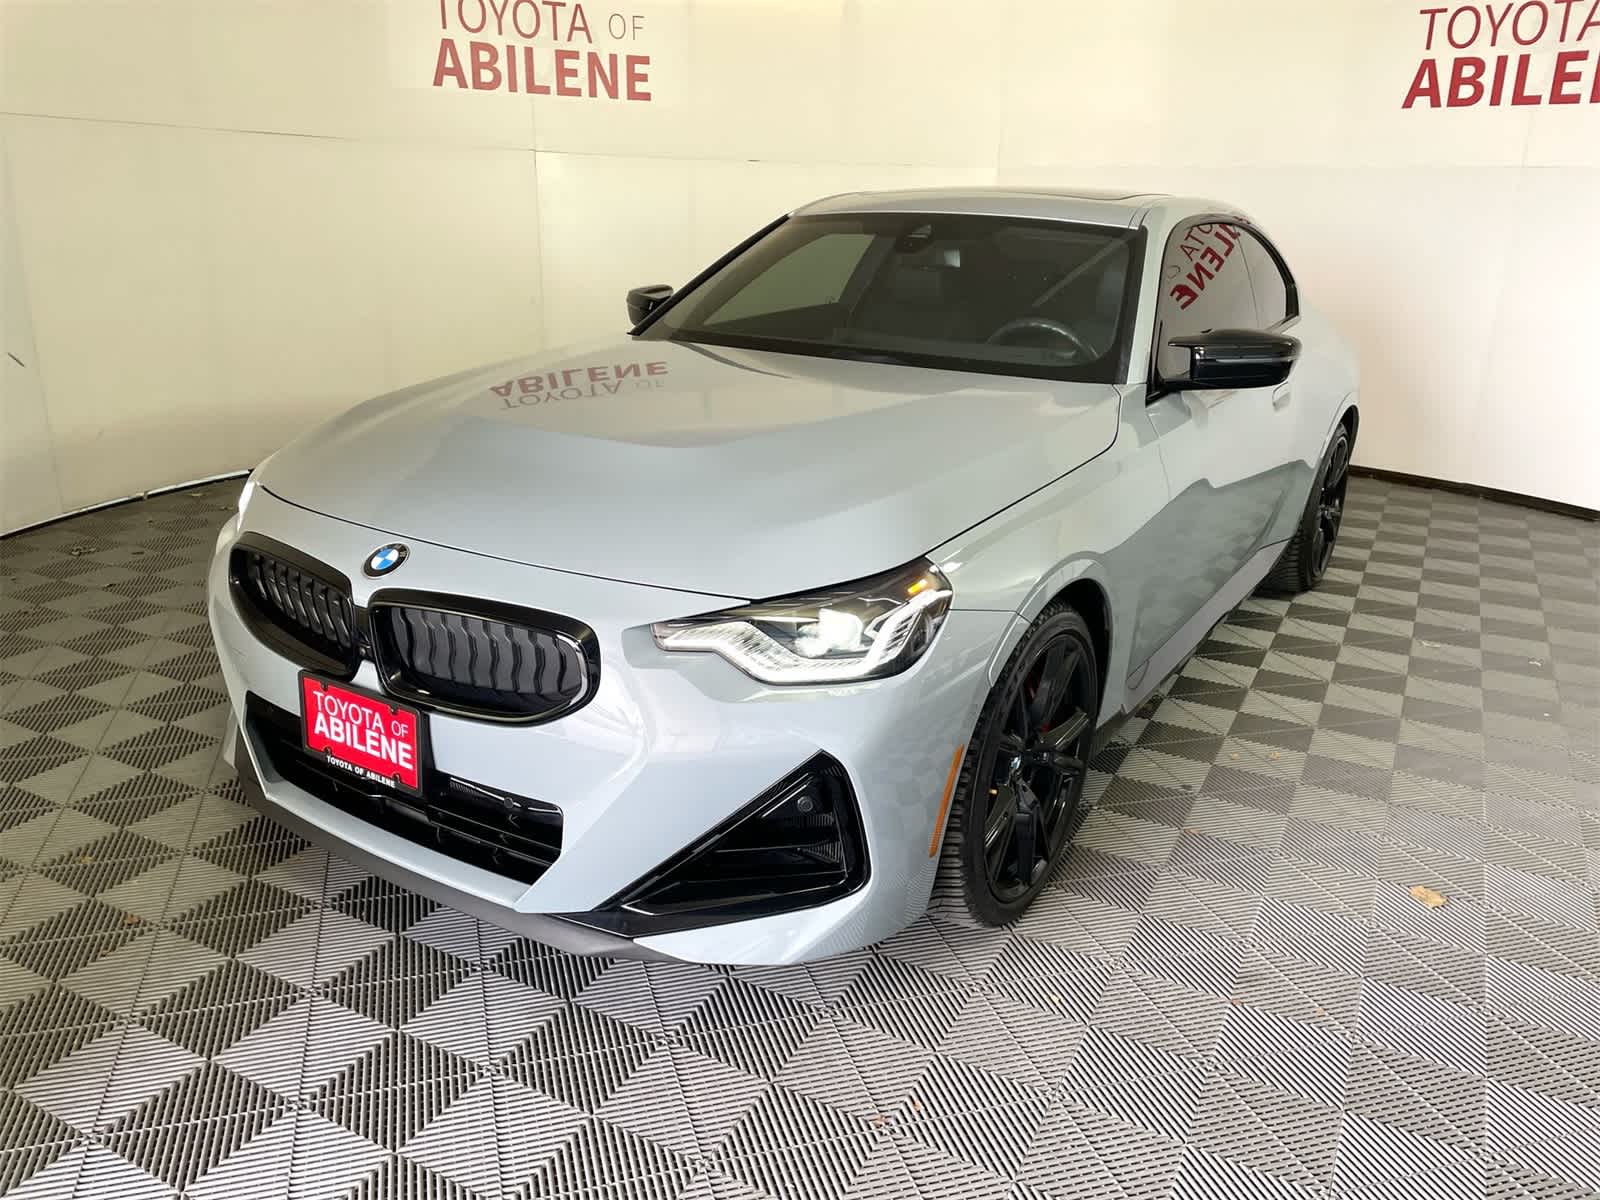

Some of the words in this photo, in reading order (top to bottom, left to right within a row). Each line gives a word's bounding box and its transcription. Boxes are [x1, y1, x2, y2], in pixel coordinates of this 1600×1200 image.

[608, 13, 645, 41] OF
[433, 38, 651, 102] ABILENE
[1401, 50, 1600, 109] ABILE
[313, 690, 385, 734] TOYOTA
[391, 720, 409, 737] OF
[314, 712, 414, 771] ABILENE
[326, 755, 353, 771] TOYOTA
[354, 766, 365, 776] OF
[366, 770, 396, 789] ABILENE
